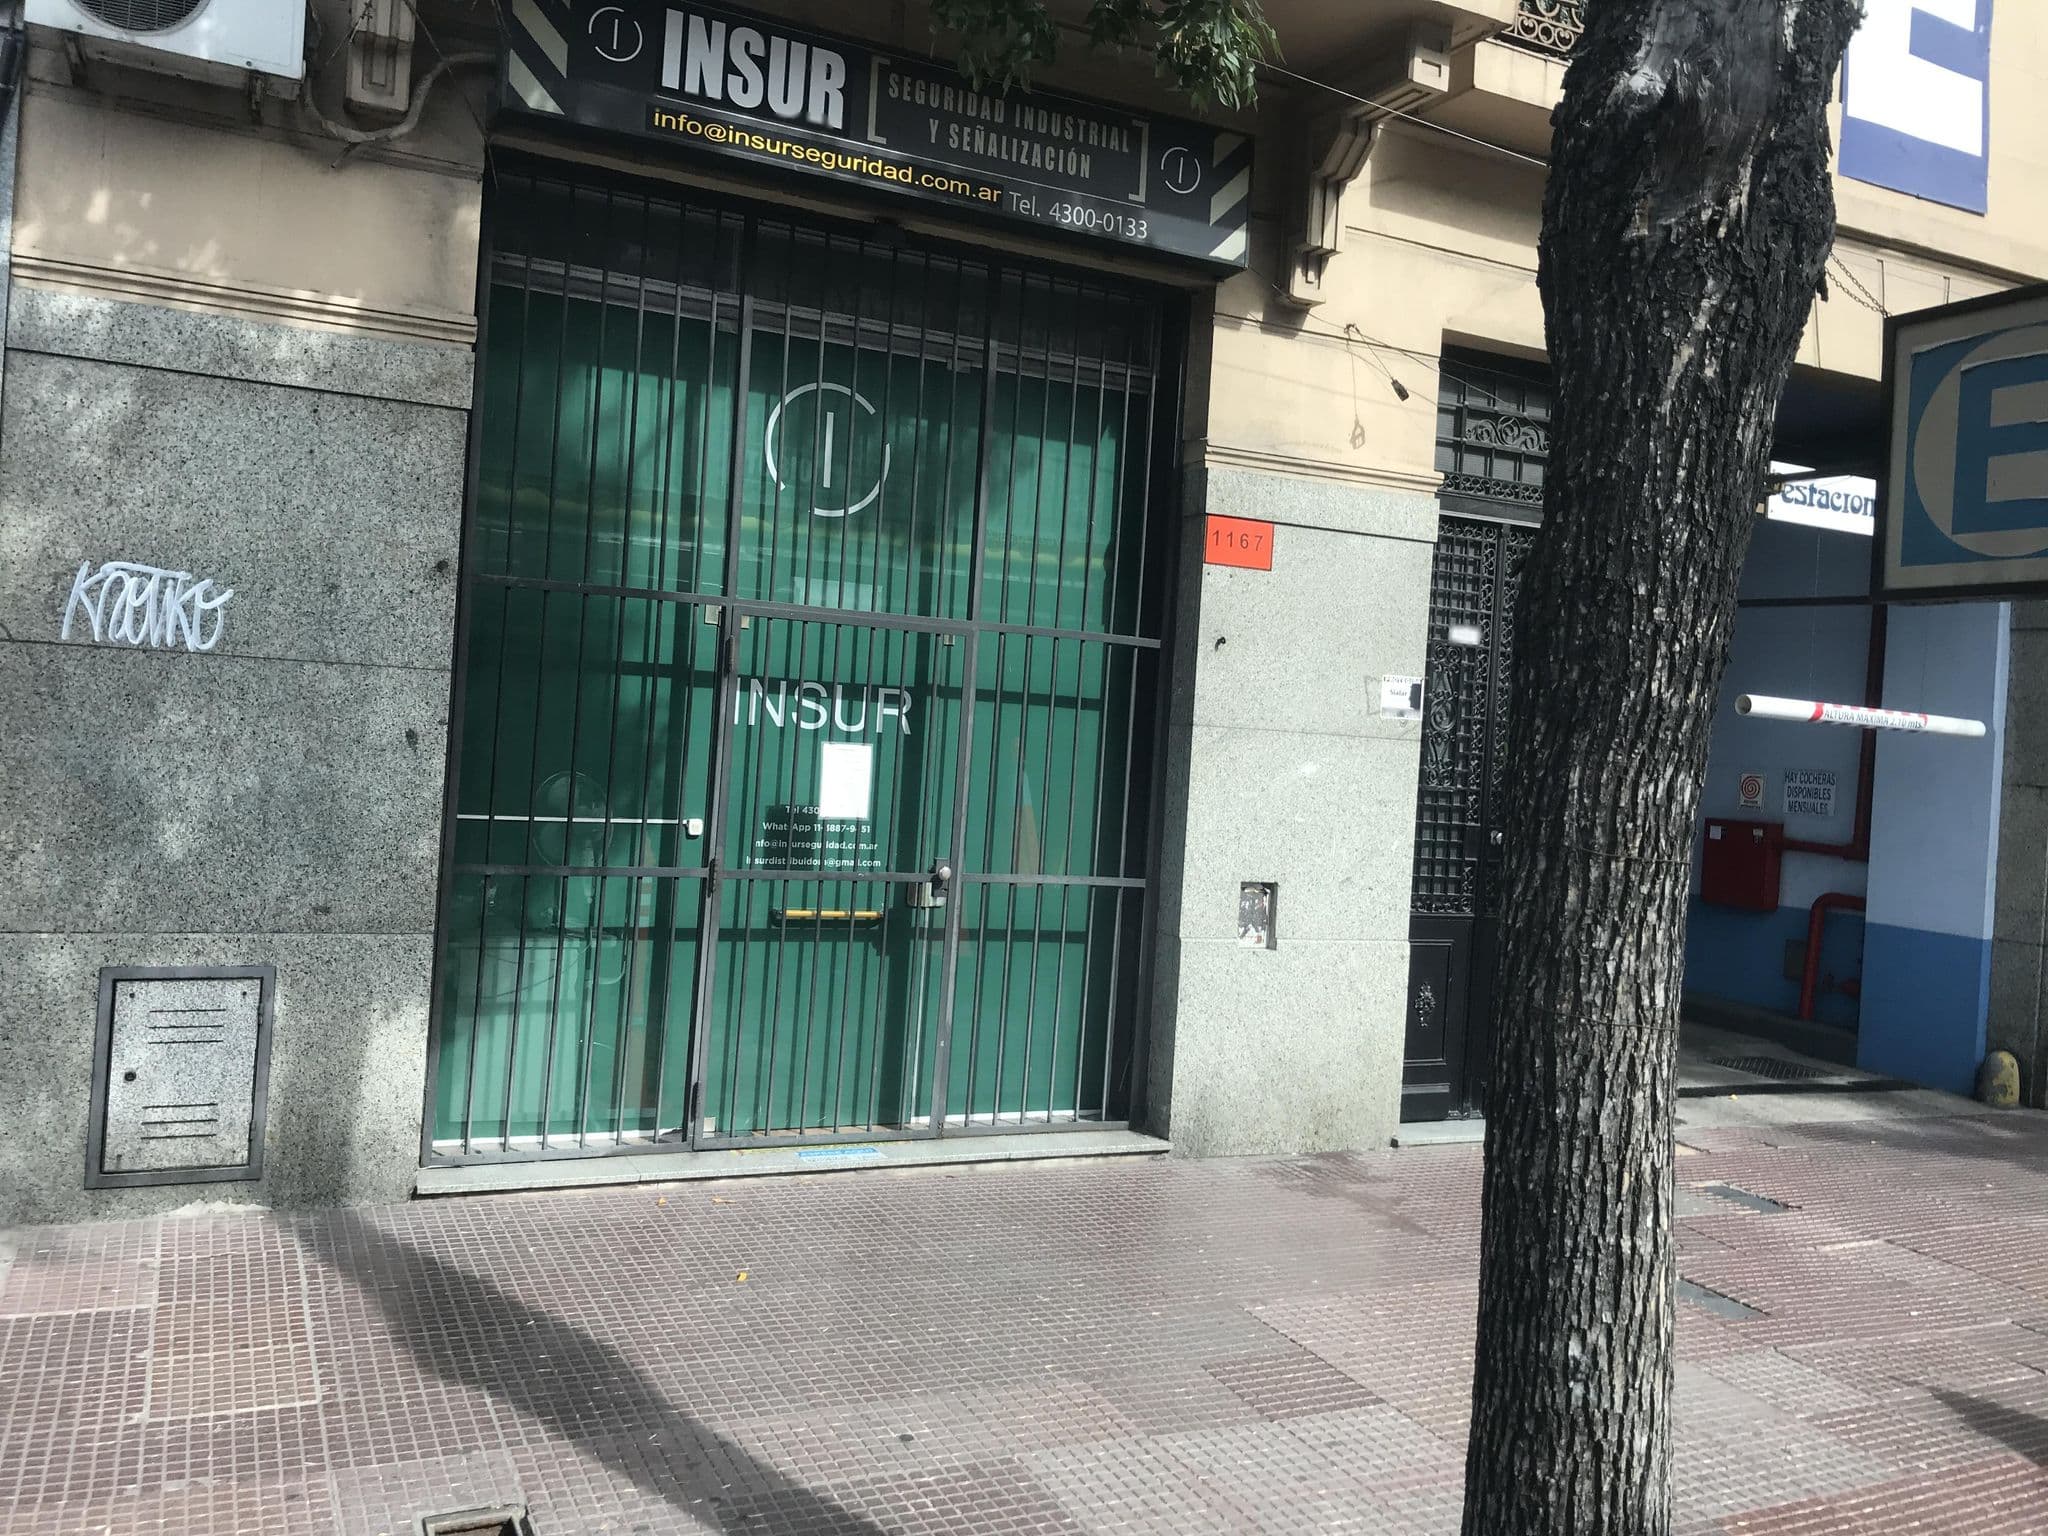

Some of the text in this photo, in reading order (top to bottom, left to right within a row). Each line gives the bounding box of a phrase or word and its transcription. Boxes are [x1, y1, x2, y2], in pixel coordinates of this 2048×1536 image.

[661, 8, 846, 129] INSUR
[888, 72, 1129, 153] SEGURIDAD INDUSTRIAL
[928, 118, 1091, 179] Y SEÑALIZACIÓN
[654, 108, 1149, 239] info@insurseguridad.com.ar Tel. 4300-0133
[1212, 530, 1264, 552] 1167
[733, 677, 912, 735] INSUR
[1824, 709, 1855, 721] ALTURA
[1784, 770, 1836, 786] HAY COCHERAS
[1787, 785, 1832, 800] DISPONIBLES
[1787, 800, 1829, 815] MENSUALES
